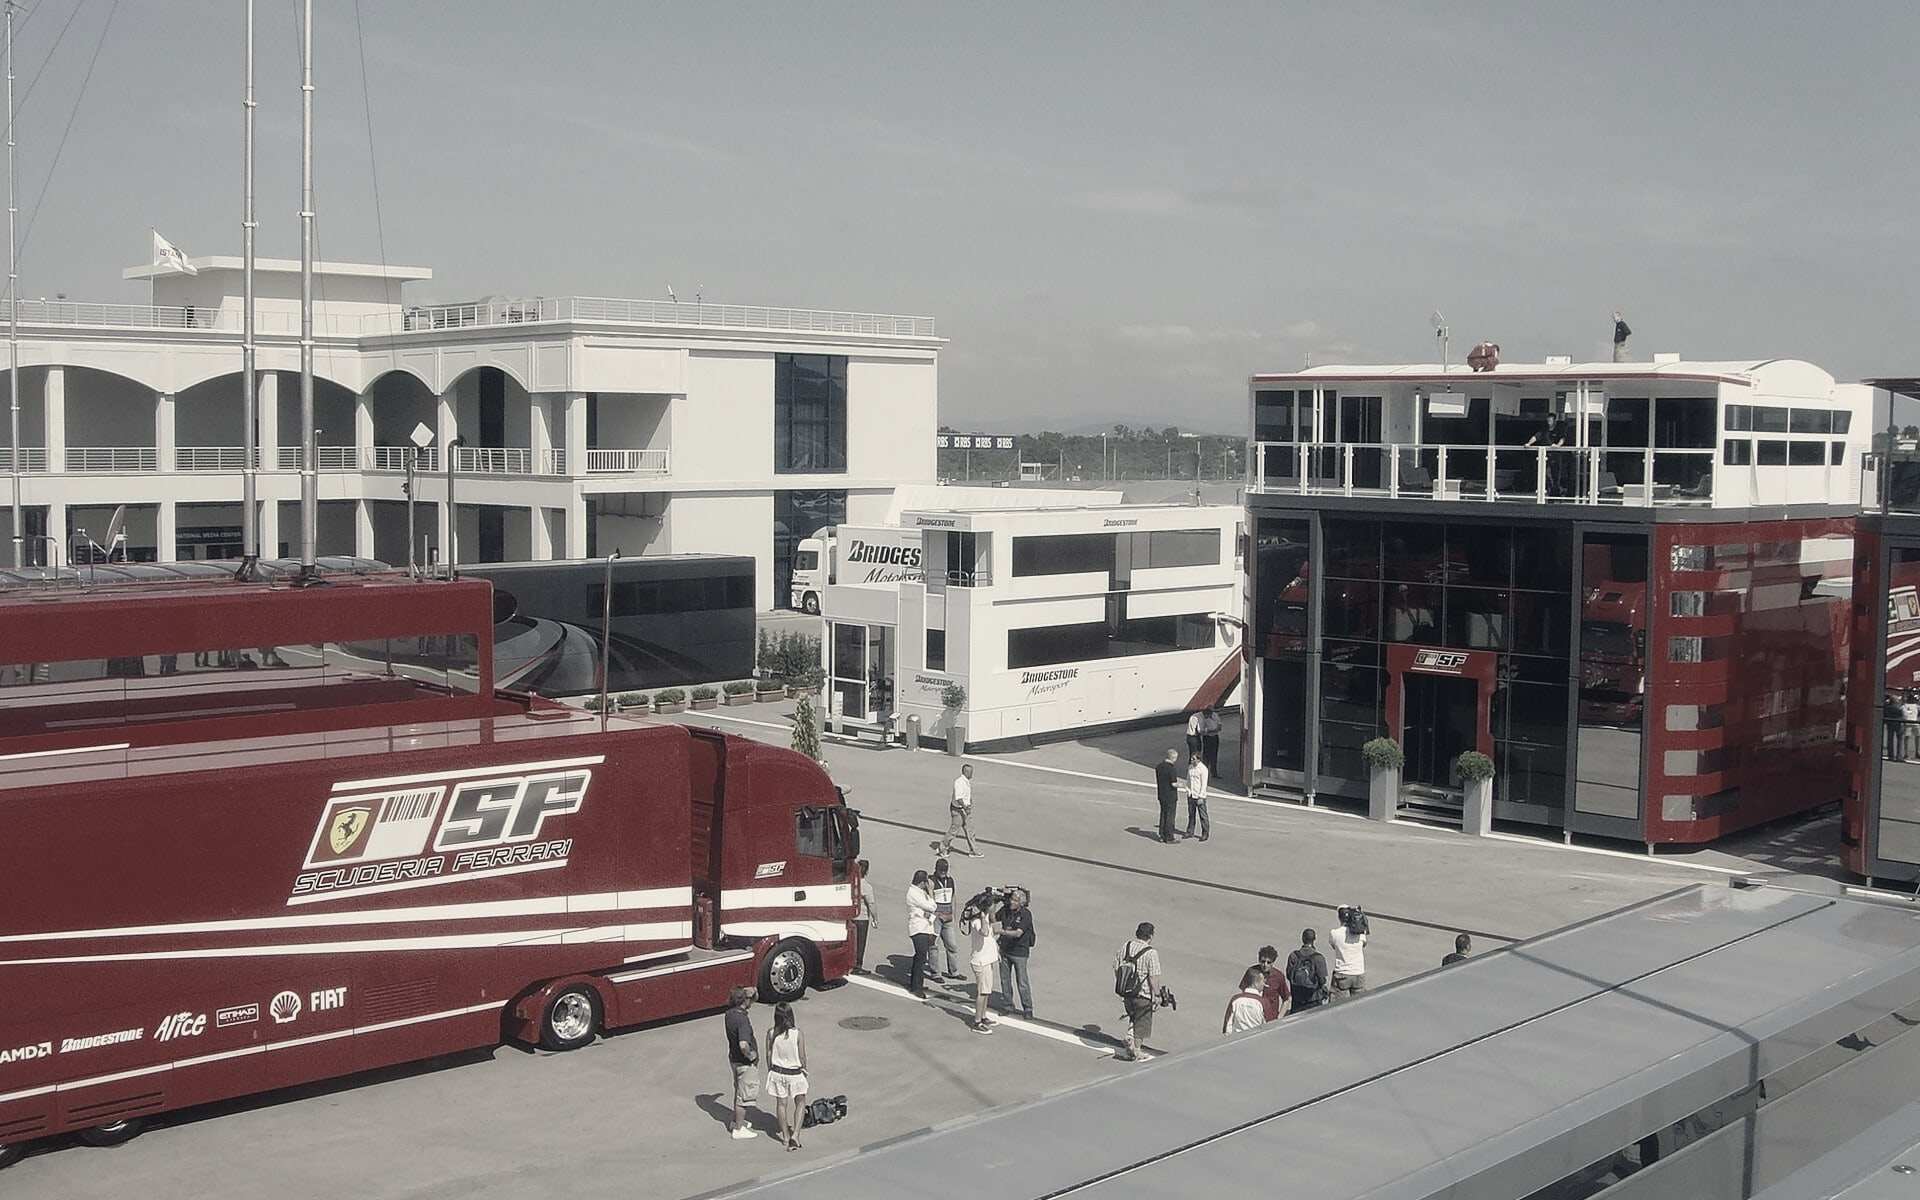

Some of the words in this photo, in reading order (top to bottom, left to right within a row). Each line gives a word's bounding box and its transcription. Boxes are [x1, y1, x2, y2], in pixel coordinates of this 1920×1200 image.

[848, 540, 921, 566] BRIDGES
[1436, 653, 1467, 667] SF
[1021, 668, 1079, 684] BRIDGESTONE
[433, 769, 592, 852] SF
[292, 855, 443, 894] SCUDERIA
[452, 839, 573, 872] FERRARI
[311, 987, 347, 1012] FIAT
[219, 1007, 257, 1020] ETIHAD
[153, 1011, 207, 1042] Alice
[60, 1028, 145, 1053] BRIDGESTONE
[0, 1046, 38, 1063] AMD
